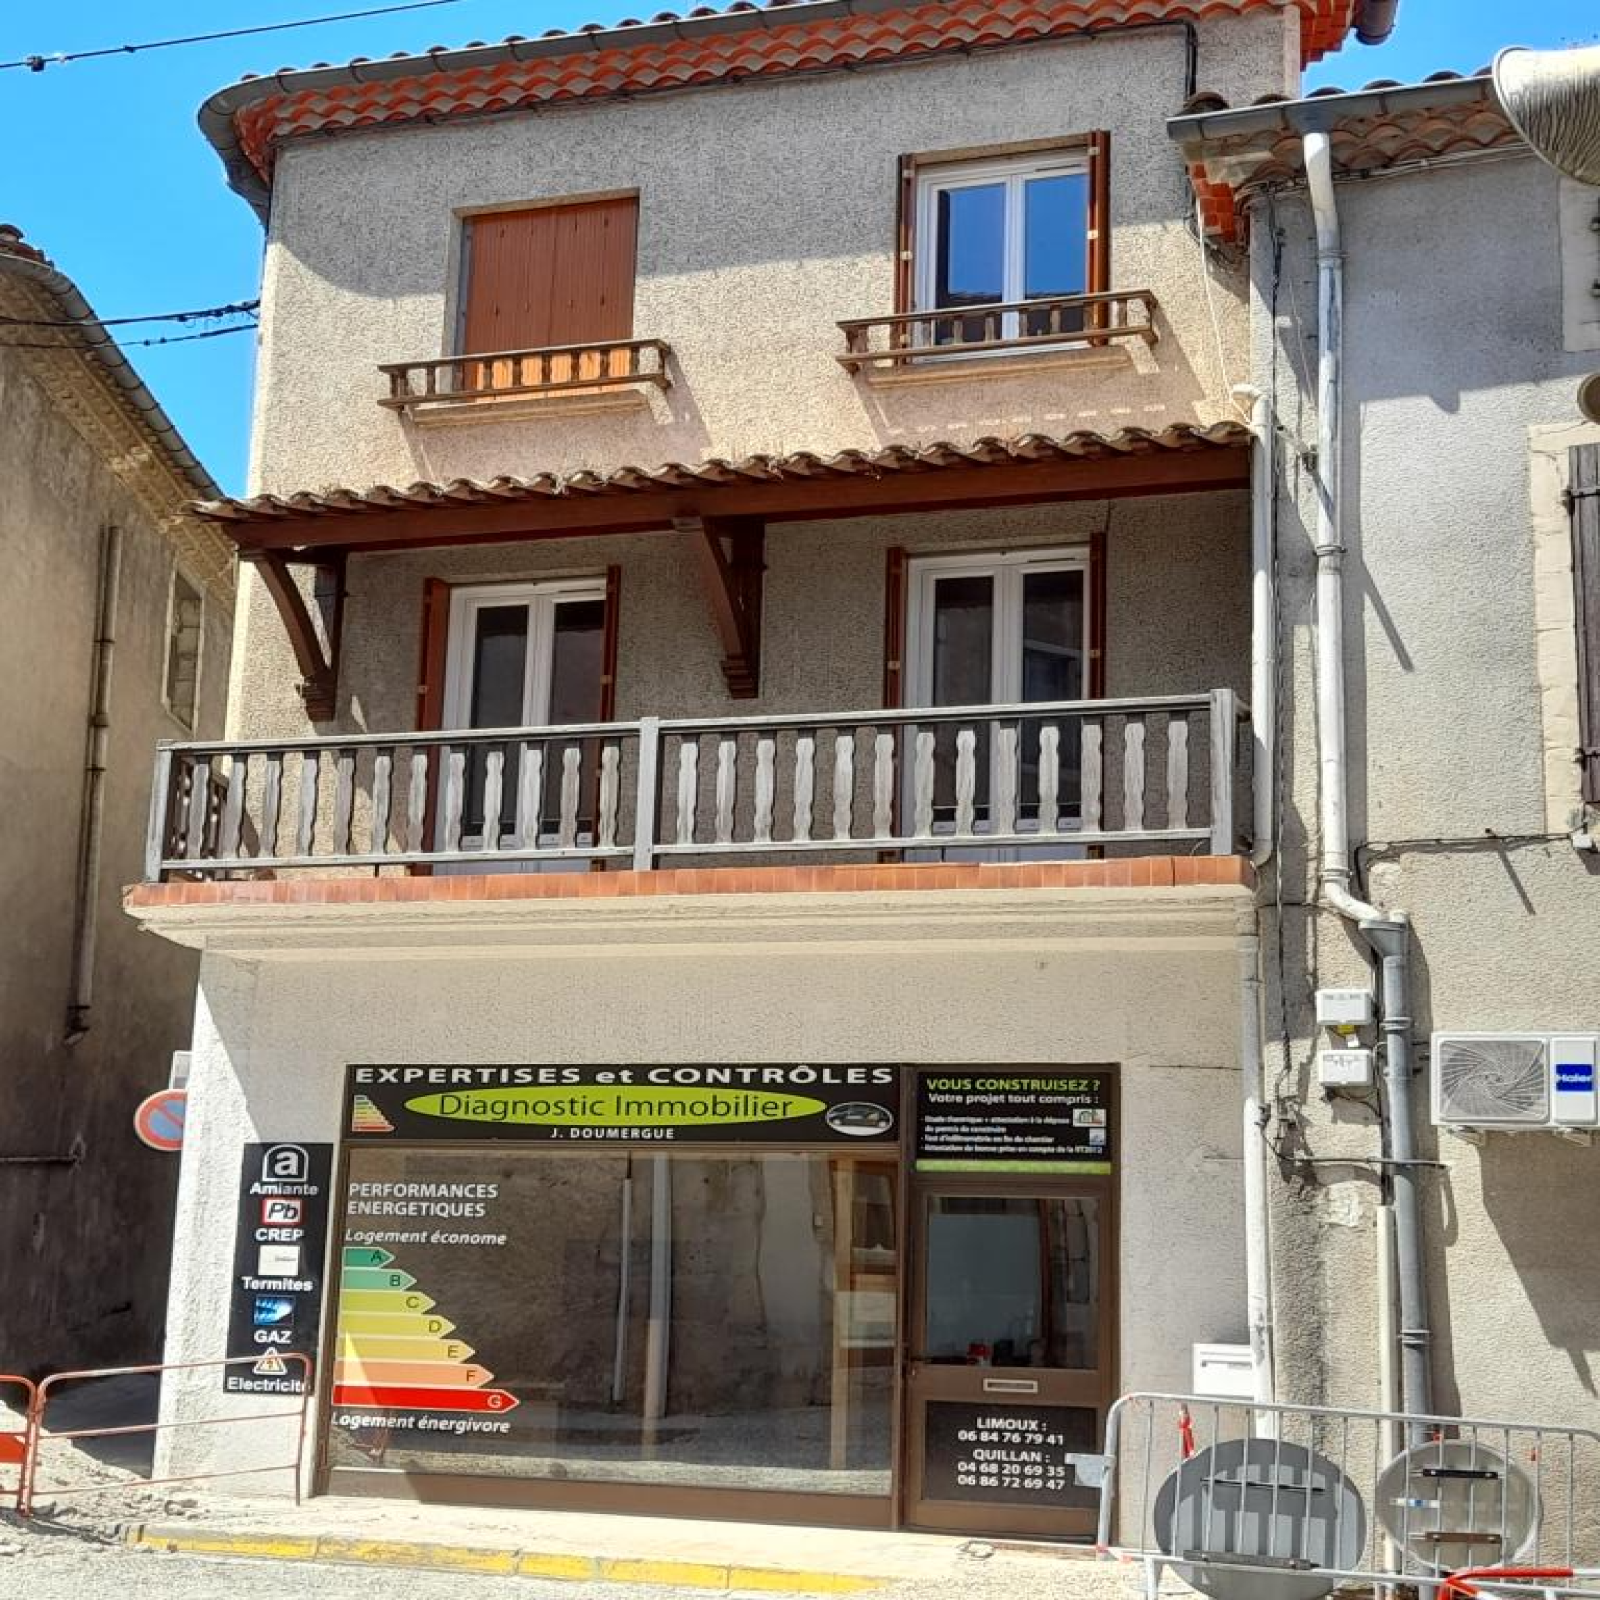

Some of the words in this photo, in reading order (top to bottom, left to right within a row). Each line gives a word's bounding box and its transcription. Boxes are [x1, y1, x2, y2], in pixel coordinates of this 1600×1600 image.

[355, 1068, 581, 1084] EXPERTISES
[595, 1068, 634, 1084] et
[648, 1065, 893, 1084] CONTRÔLES
[926, 1078, 972, 1090] VOUS
[975, 1078, 1089, 1092] CONSTRUISEZ
[929, 1093, 963, 1103] Votre
[966, 1093, 1005, 1105] projet
[1008, 1094, 1036, 1104] tout
[1039, 1094, 1091, 1106] compris
[439, 1094, 604, 1121] Diagnostic
[615, 1094, 795, 1117] Immobilier
[550, 1127, 564, 1139] J.
[570, 1127, 675, 1140] DOUMERGUE
[274, 1151, 299, 1176] a
[249, 1182, 320, 1196] Amiante
[349, 1182, 499, 1199] PERFORMANCES
[268, 1202, 299, 1220] Pb
[347, 1200, 487, 1218] ENERGETIQUES
[255, 1228, 305, 1241] CREP
[345, 1227, 428, 1245] Logement
[430, 1229, 508, 1246] économe
[370, 1249, 383, 1262] A
[242, 1276, 314, 1292] Termites
[389, 1274, 401, 1287] B
[405, 1295, 420, 1309] C
[428, 1319, 442, 1334] D
[253, 1329, 293, 1344] GAZ
[447, 1345, 459, 1359] E
[466, 1369, 476, 1382] F
[227, 1376, 311, 1393] Electricit
[487, 1394, 503, 1408] G
[331, 1411, 415, 1430] Logement
[418, 1414, 511, 1434] énergivore
[976, 1416, 1039, 1431] LIMOUX
[957, 1430, 978, 1442] 06
[979, 1431, 999, 1443] 84
[1001, 1432, 1021, 1444] 76
[1024, 1433, 1043, 1445] 79
[1045, 1434, 1064, 1446] 41
[972, 1448, 1043, 1463] QUILLAN
[957, 1461, 978, 1473] 04
[979, 1462, 999, 1474] 68
[1001, 1464, 1021, 1476] 20
[1024, 1465, 1043, 1477] 69
[1045, 1466, 1066, 1478] 35
[957, 1475, 978, 1487] 06
[979, 1476, 999, 1488] 86
[1001, 1477, 1021, 1489] 72
[1024, 1478, 1043, 1490] 69
[1045, 1479, 1066, 1491] 47
